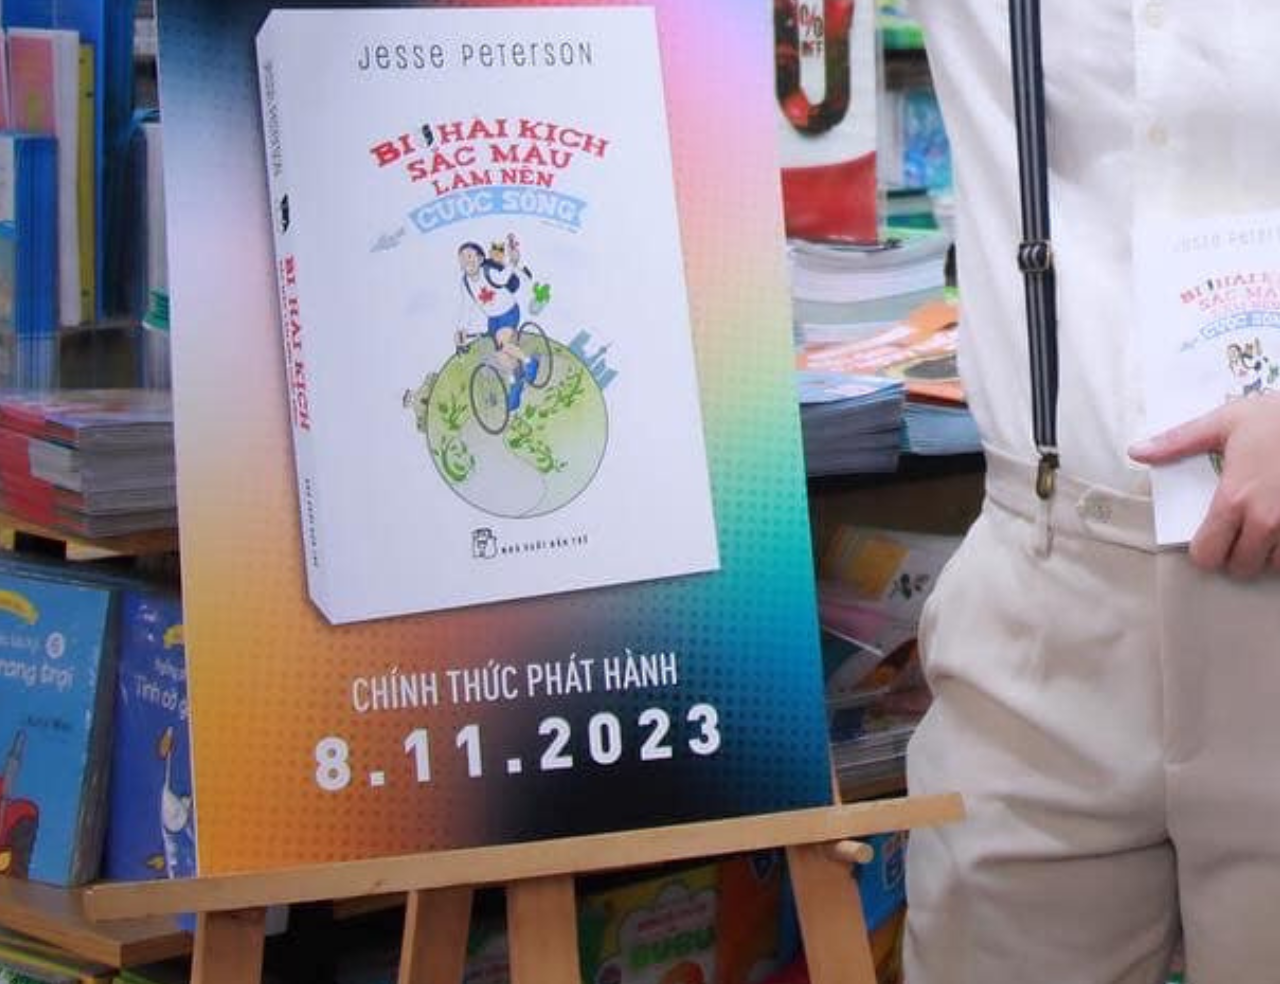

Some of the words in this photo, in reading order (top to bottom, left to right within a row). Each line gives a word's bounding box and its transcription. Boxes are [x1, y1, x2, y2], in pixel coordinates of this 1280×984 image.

[369, 133, 416, 169] BI
[351, 664, 439, 714] CHÍNH
[446, 658, 519, 706] THỨC
[526, 651, 595, 698] PHÁT
[602, 646, 679, 693] HÀNH
[313, 701, 722, 792] 8.11.2023
